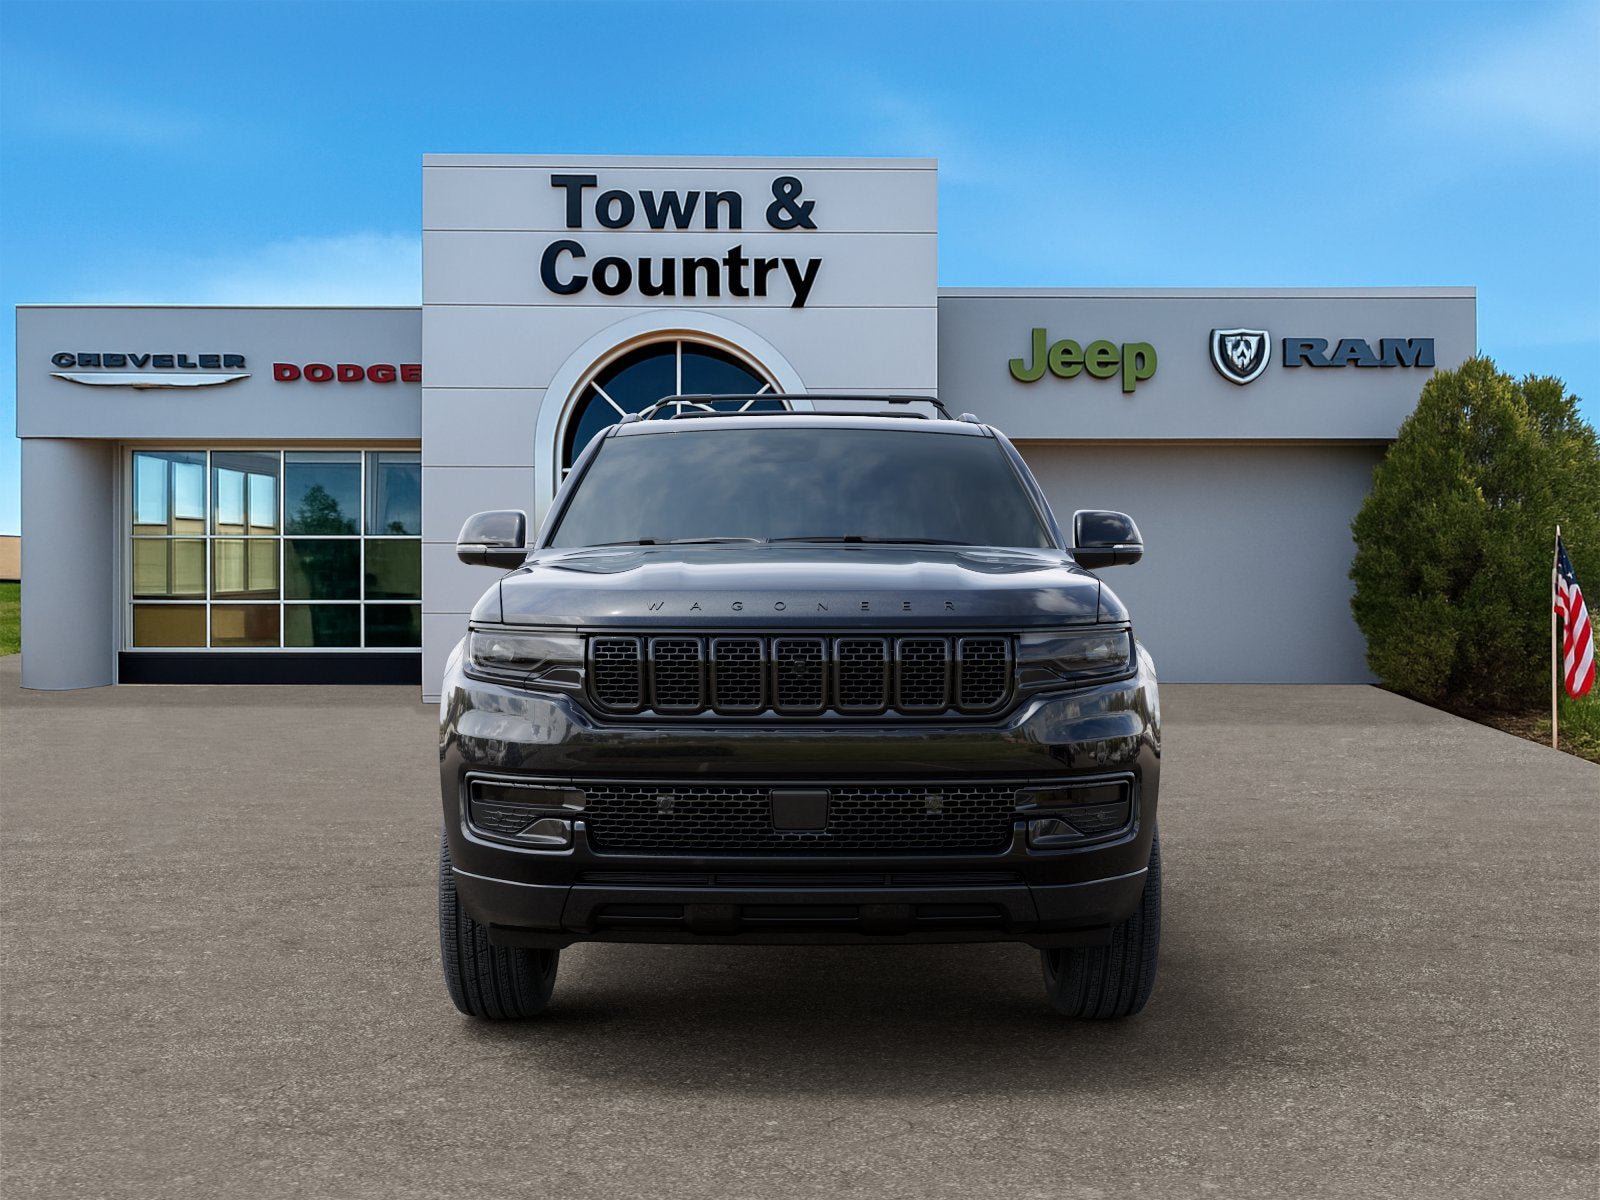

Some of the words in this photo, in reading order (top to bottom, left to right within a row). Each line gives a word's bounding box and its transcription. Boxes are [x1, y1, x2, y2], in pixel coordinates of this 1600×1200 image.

[550, 174, 743, 230] Town
[765, 175, 818, 231] &
[540, 239, 823, 309] Country
[273, 362, 422, 383] DODGE
[1009, 327, 1158, 393] Jeep
[1282, 337, 1436, 368] RAM
[647, 601, 957, 612] WAGONEER
